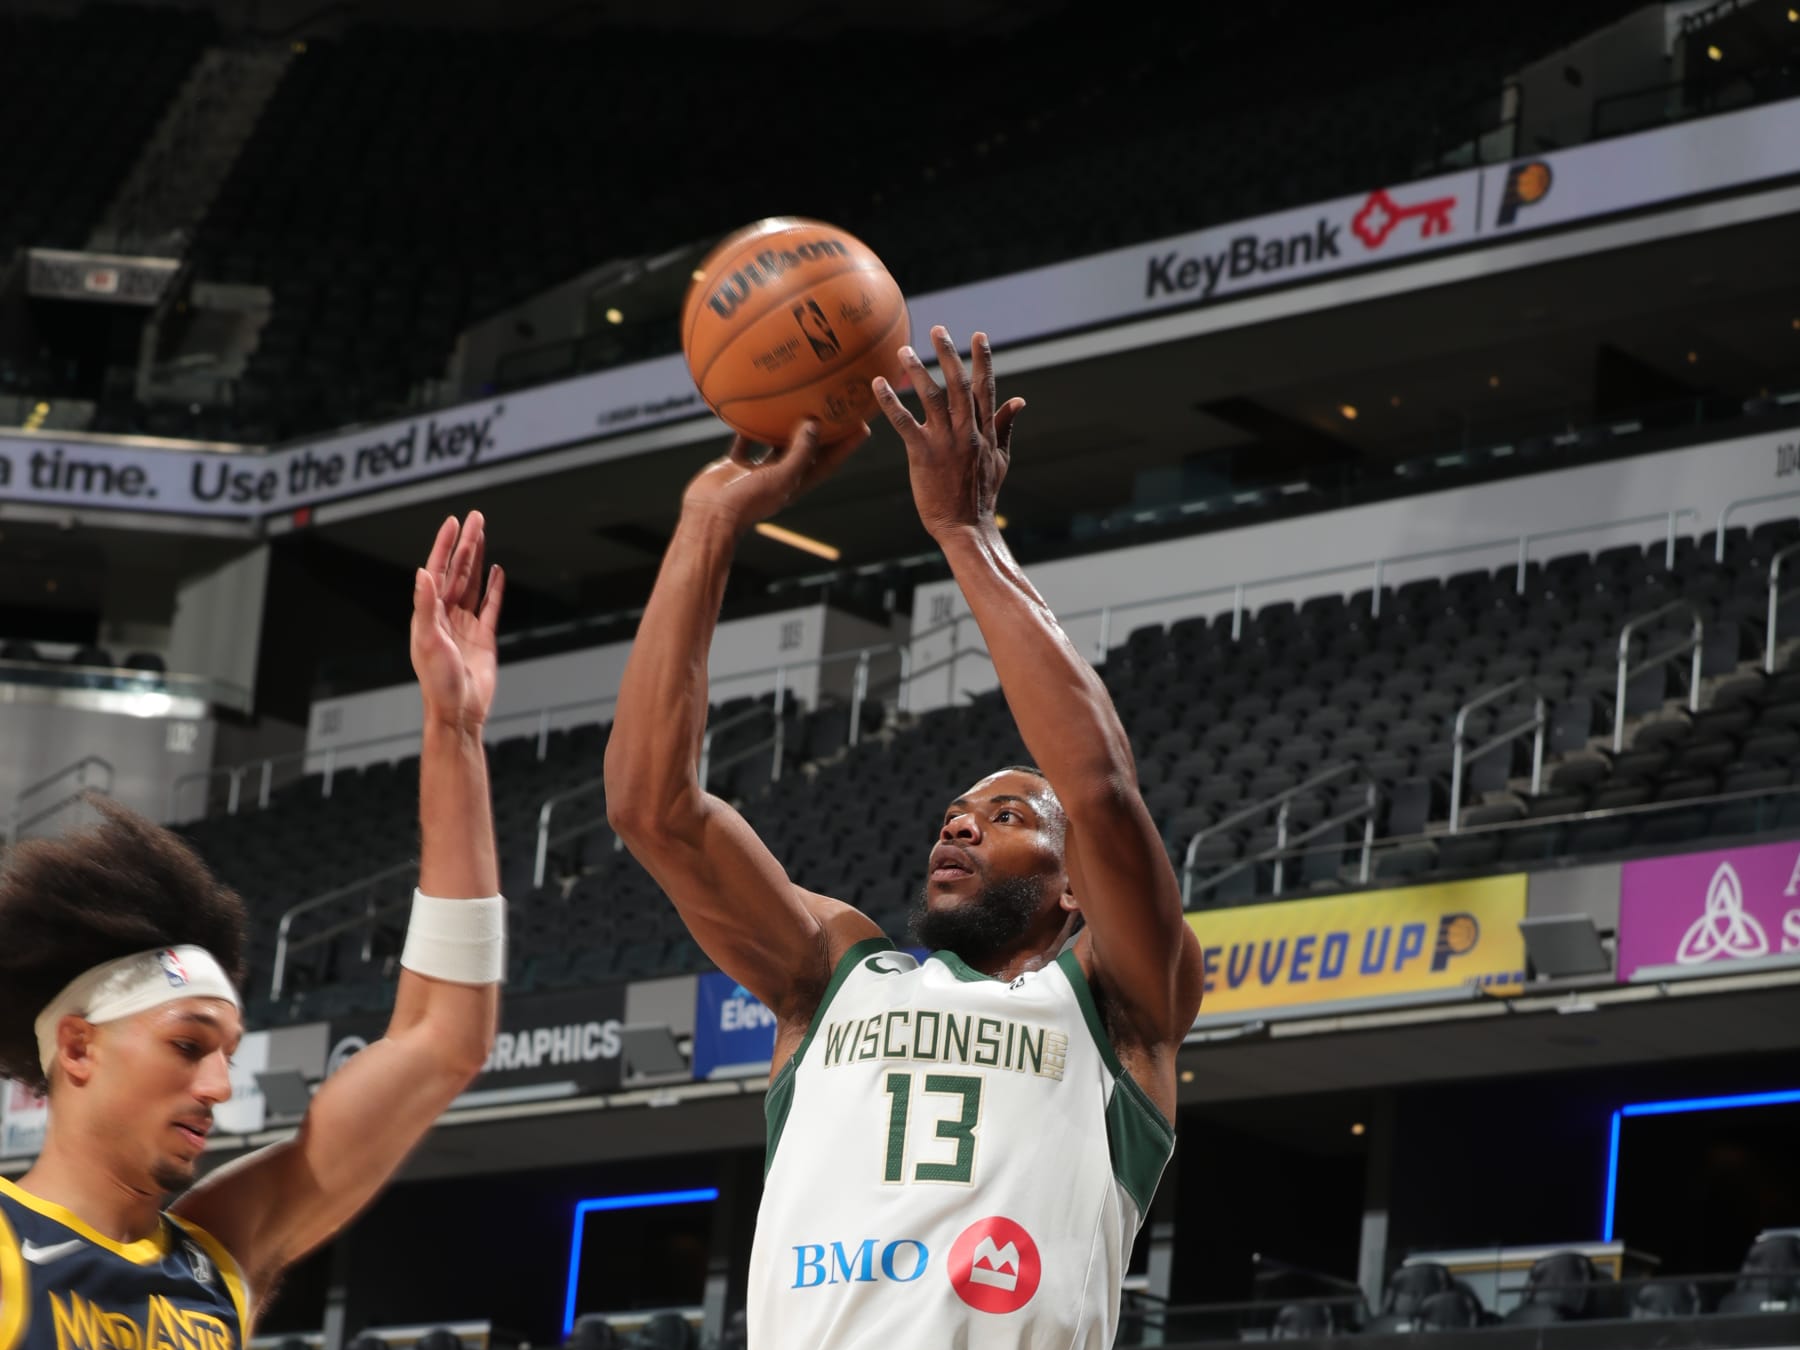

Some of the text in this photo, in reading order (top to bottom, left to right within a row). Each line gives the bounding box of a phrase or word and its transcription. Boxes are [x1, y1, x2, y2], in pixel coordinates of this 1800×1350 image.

[1145, 218, 1341, 299] KeyBank
[29, 449, 158, 497] time.
[191, 459, 278, 503] Use
[288, 451, 345, 494] the
[354, 423, 418, 478] red
[1203, 931, 1350, 992] EVVED
[1359, 922, 1427, 976] UP
[823, 1009, 1047, 1077] WISCONSIN
[882, 1068, 986, 1188] 13
[791, 1239, 930, 1289] BMO
